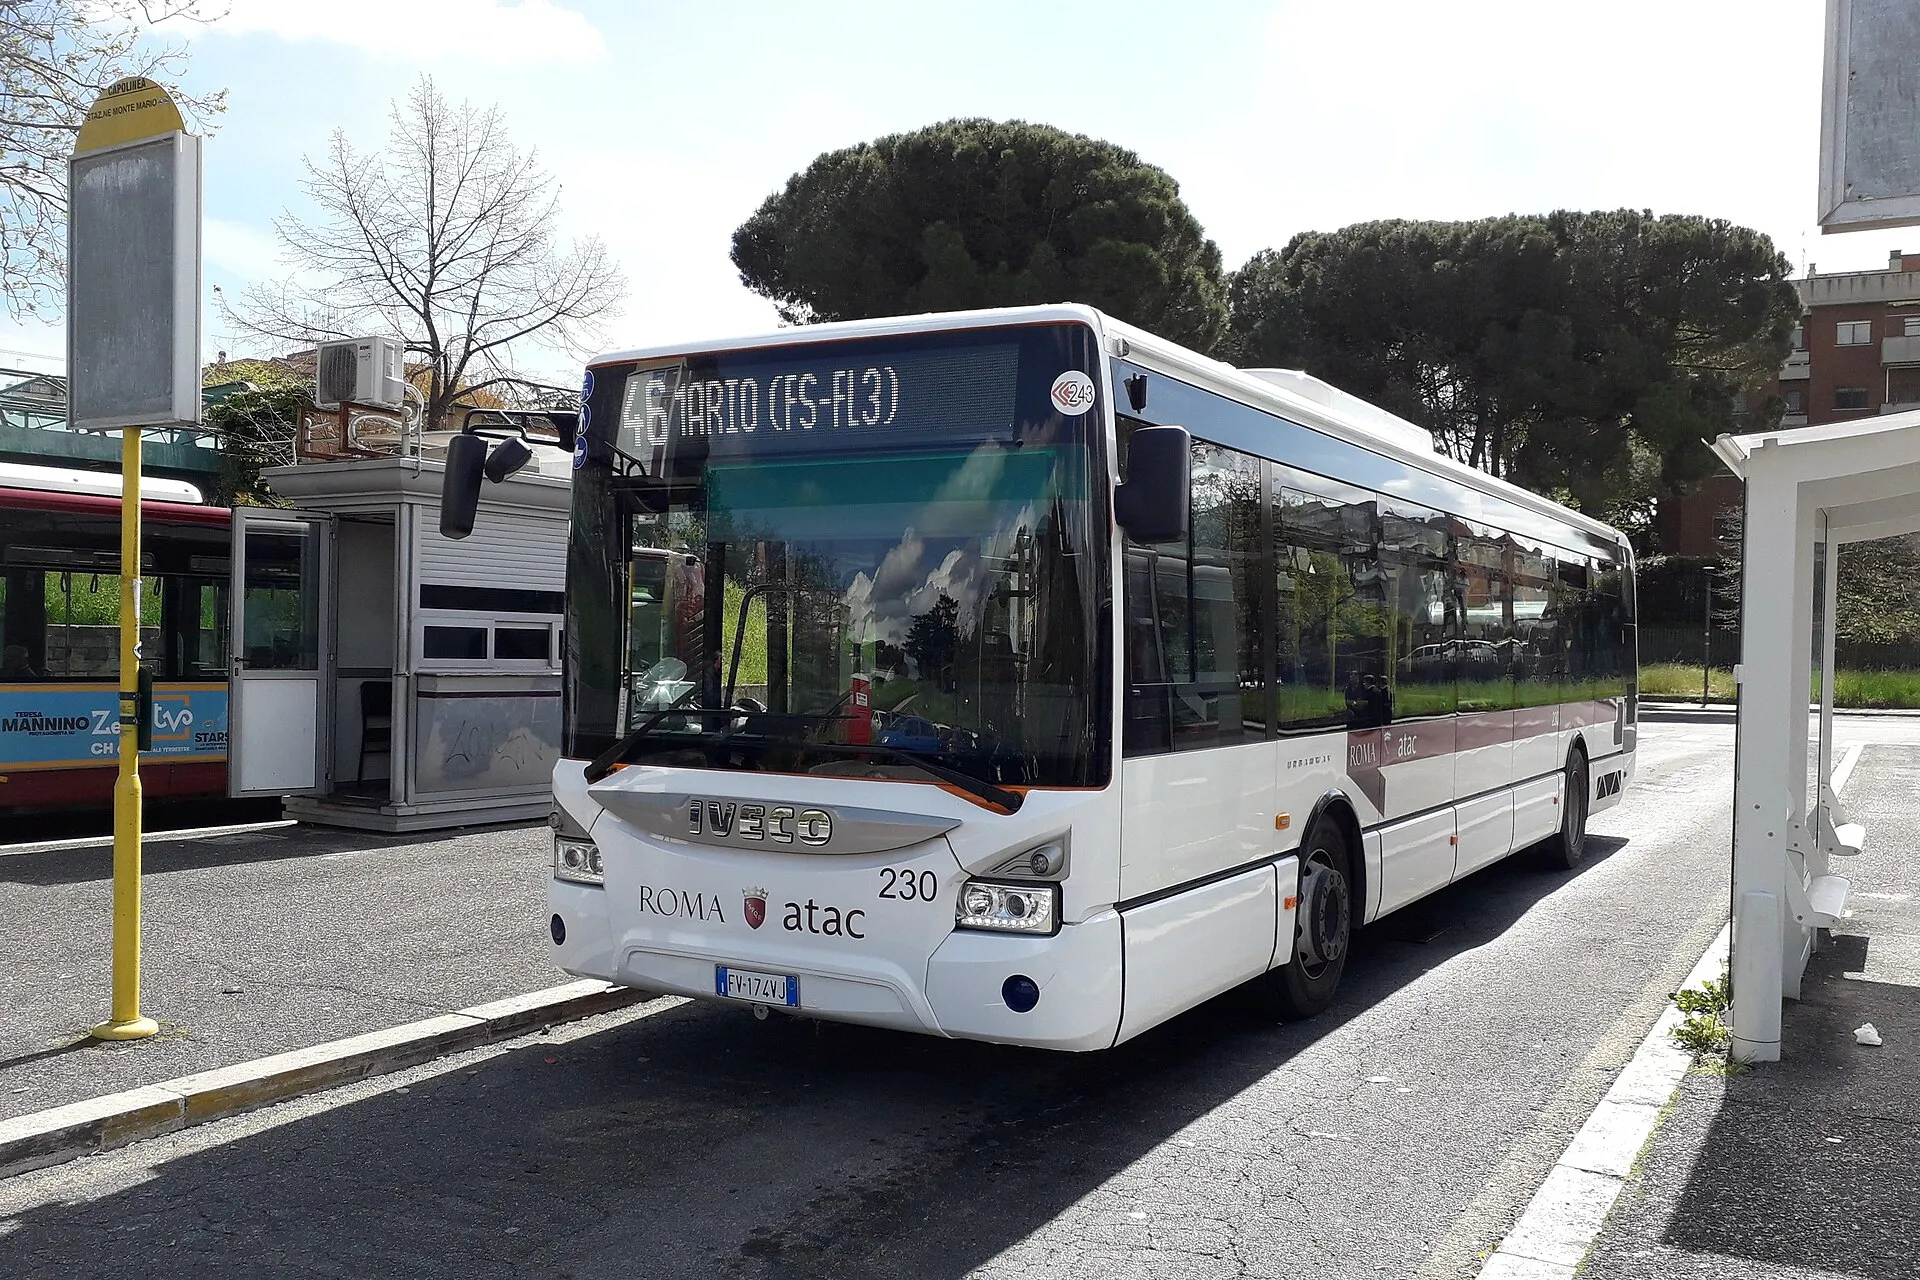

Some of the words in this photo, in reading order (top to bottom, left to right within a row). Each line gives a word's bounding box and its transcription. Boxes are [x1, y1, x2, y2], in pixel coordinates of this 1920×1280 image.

[108, 78, 146, 95] CAPOLINEA
[112, 103, 135, 115] MONTE
[136, 98, 157, 110] MARIO
[769, 366, 899, 431] (FS-FL3)
[1069, 383, 1093, 403] 243
[623, 379, 668, 446] 46
[2, 716, 90, 732] MANNINO
[1350, 743, 1376, 767] ROMA
[1398, 733, 1417, 757] atac
[688, 799, 834, 847] IVECO
[878, 867, 938, 902] 230
[639, 885, 725, 923] ROMA
[782, 898, 866, 939] atac
